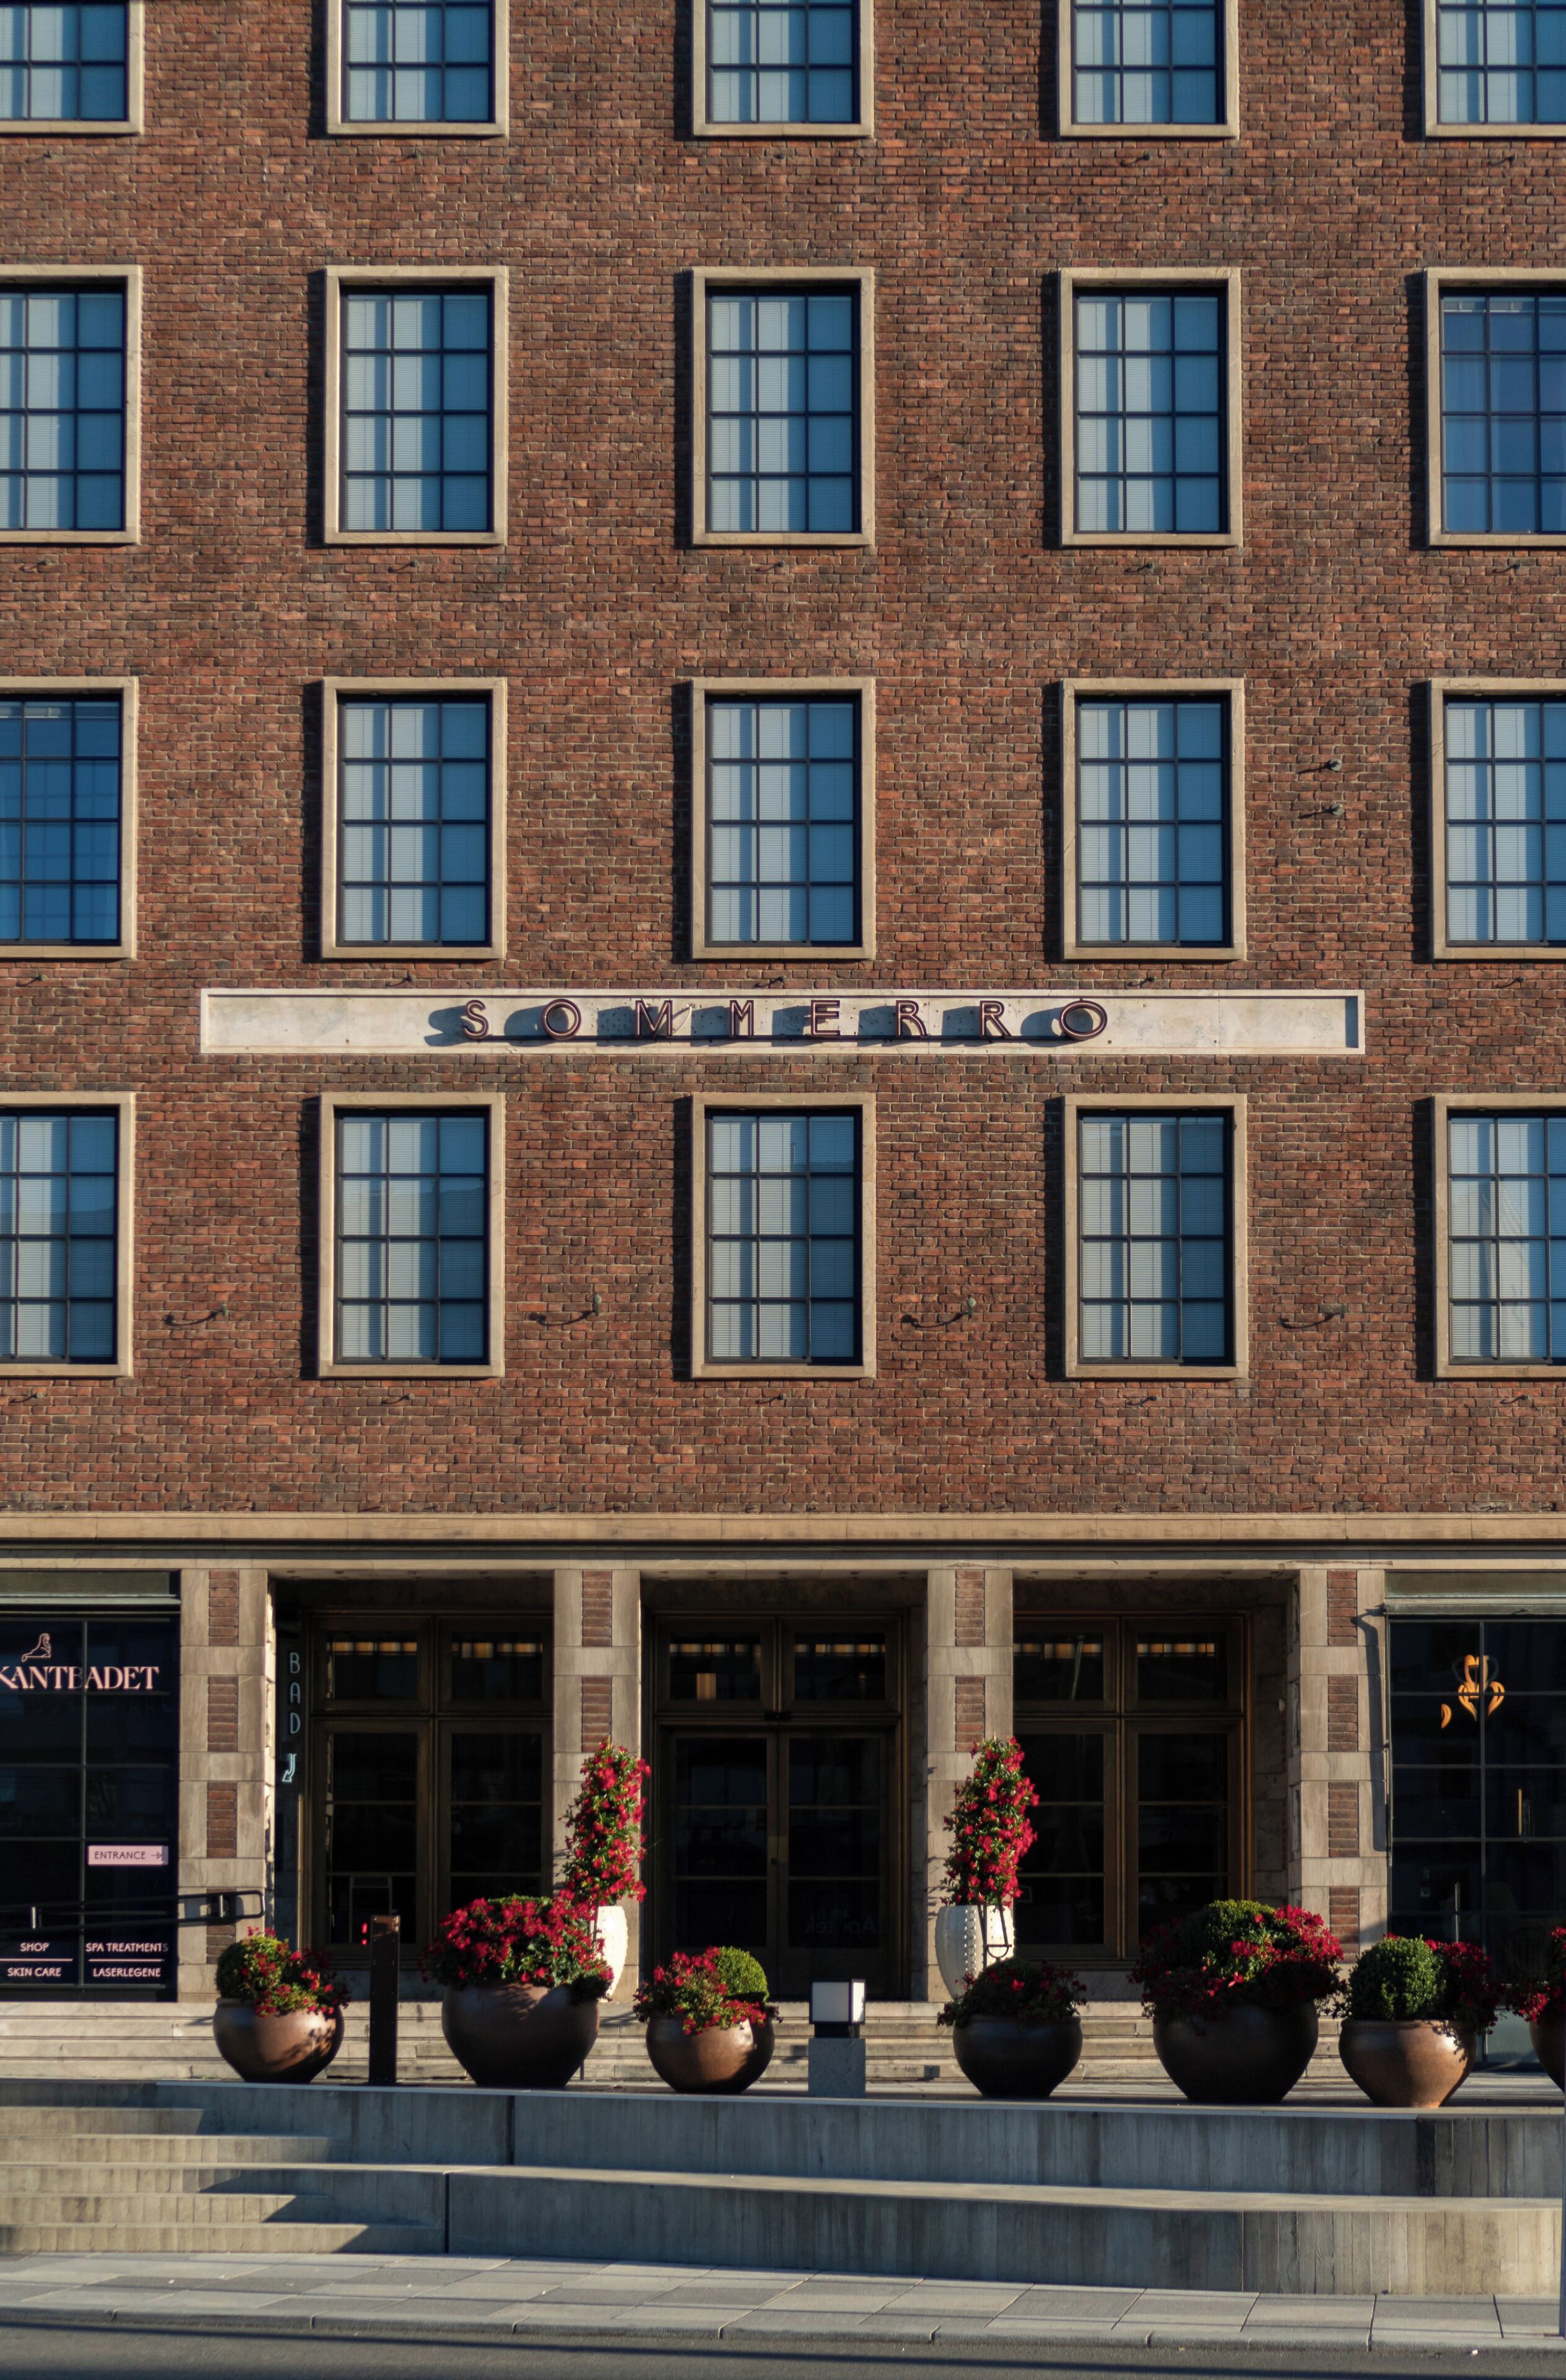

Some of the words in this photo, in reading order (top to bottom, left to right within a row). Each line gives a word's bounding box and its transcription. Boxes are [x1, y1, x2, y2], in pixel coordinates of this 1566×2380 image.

[461, 998, 1108, 1041] SOMMERRO
[290, 1652, 301, 1734] BAD
[94, 1851, 146, 1860] ENTRANCE
[20, 1942, 50, 1952] SHOP
[86, 1942, 104, 1952] SPA
[106, 1942, 169, 1952] TREATMENTS
[7, 1967, 32, 1977] SKIN
[35, 1967, 62, 1977] CARE
[92, 1967, 161, 1977] LASERLEGENE
